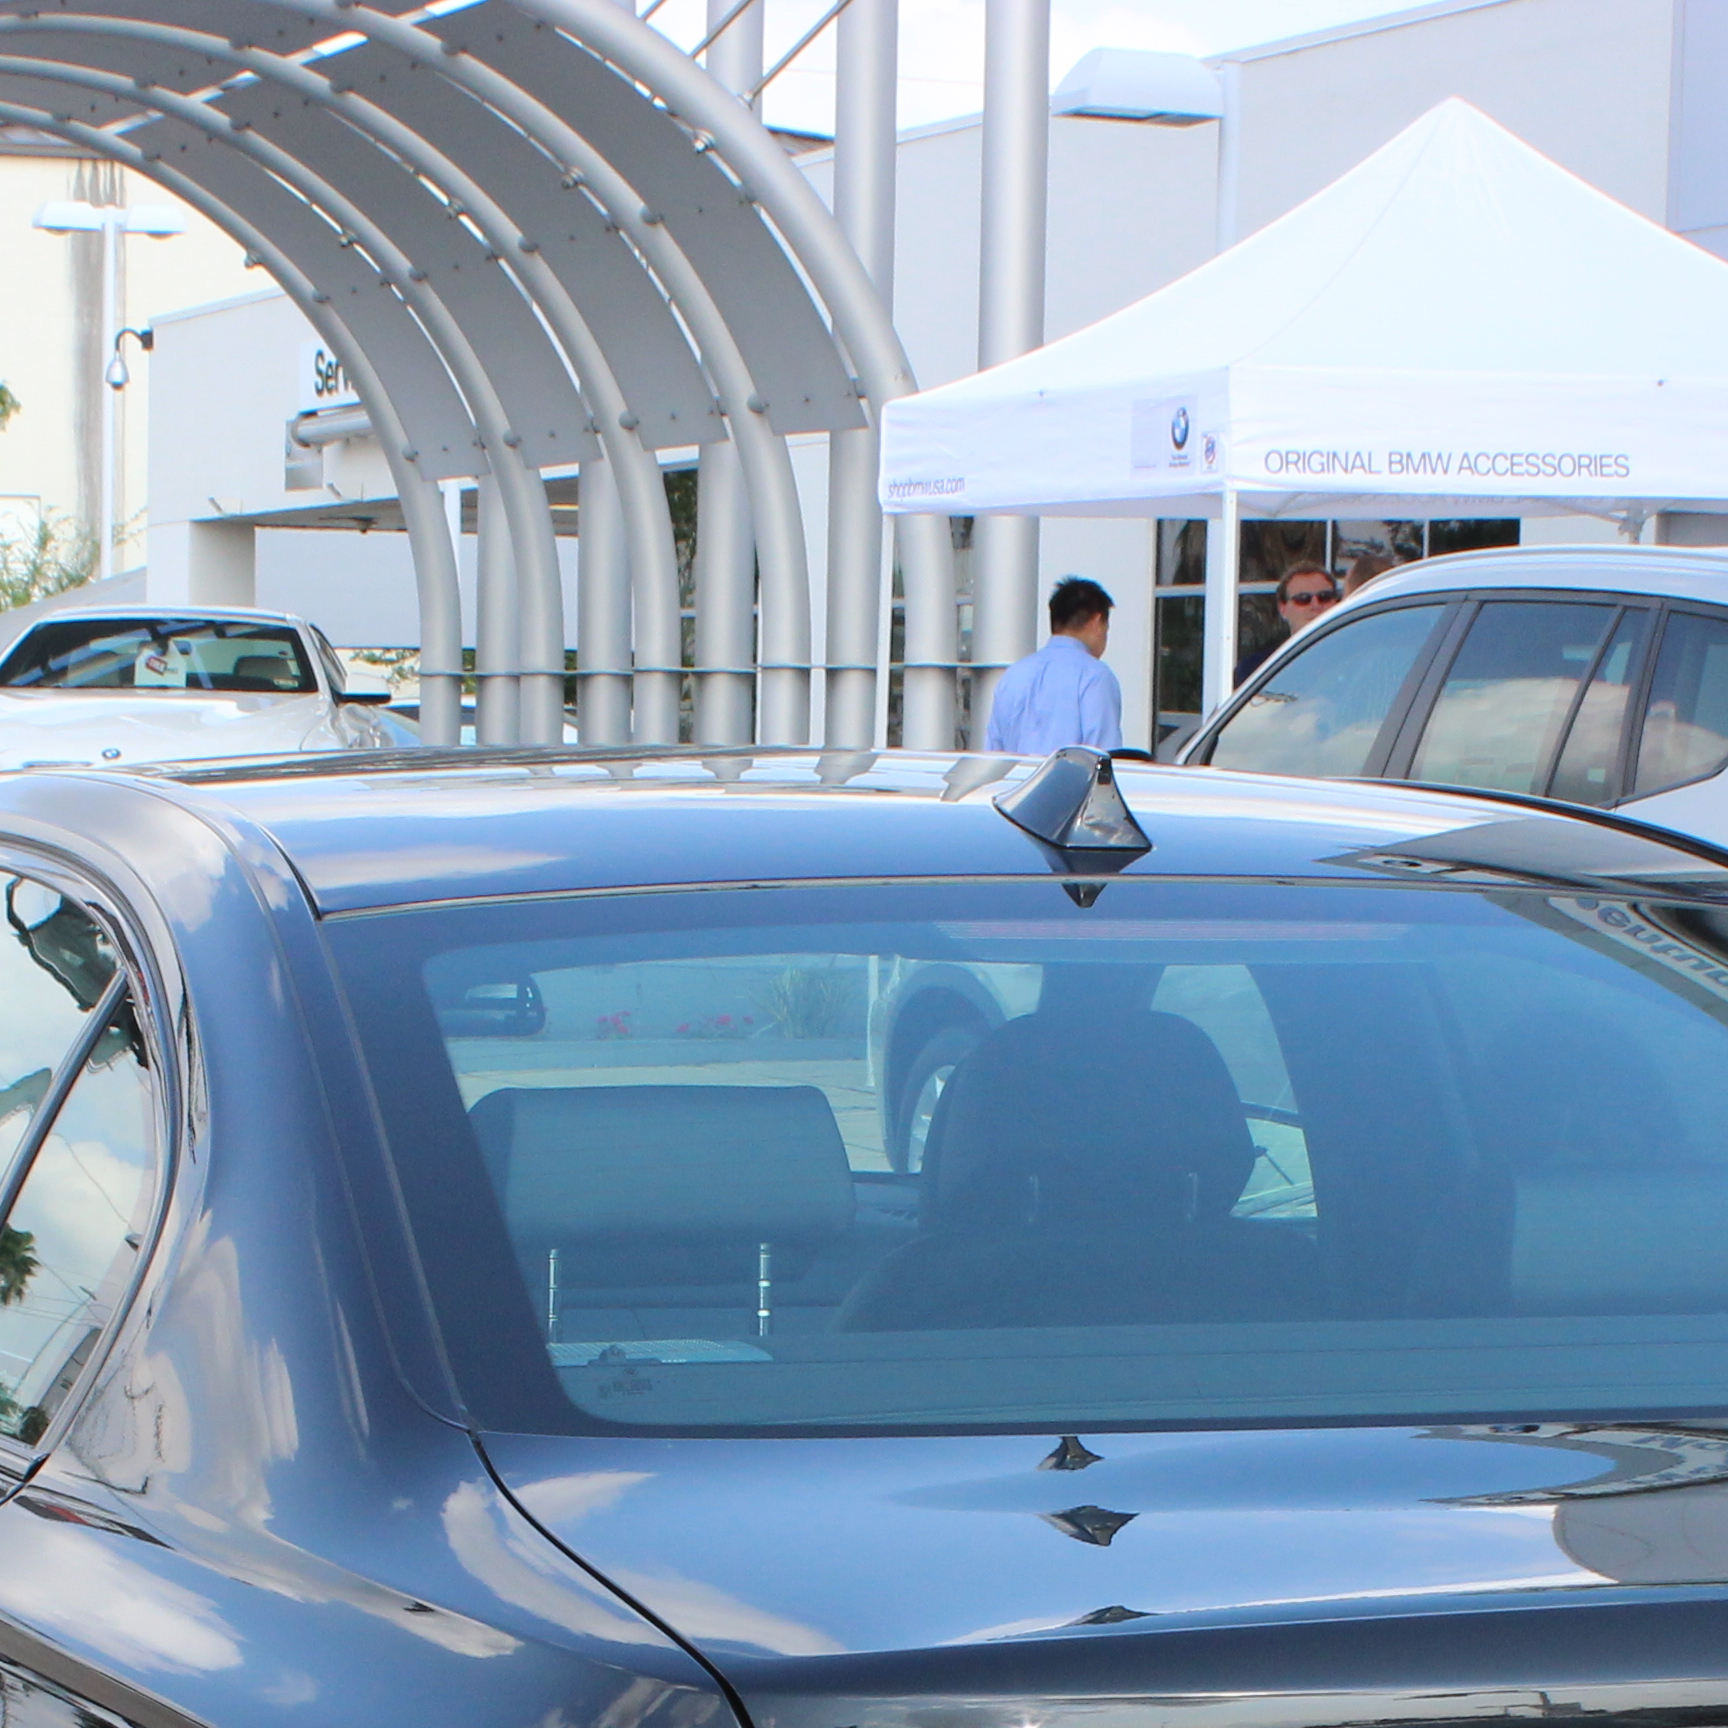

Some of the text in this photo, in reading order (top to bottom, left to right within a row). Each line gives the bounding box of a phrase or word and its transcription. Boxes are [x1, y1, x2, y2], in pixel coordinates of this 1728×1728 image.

[1264, 449, 1631, 478] ORIGINAL BMW ACCESSORIES
